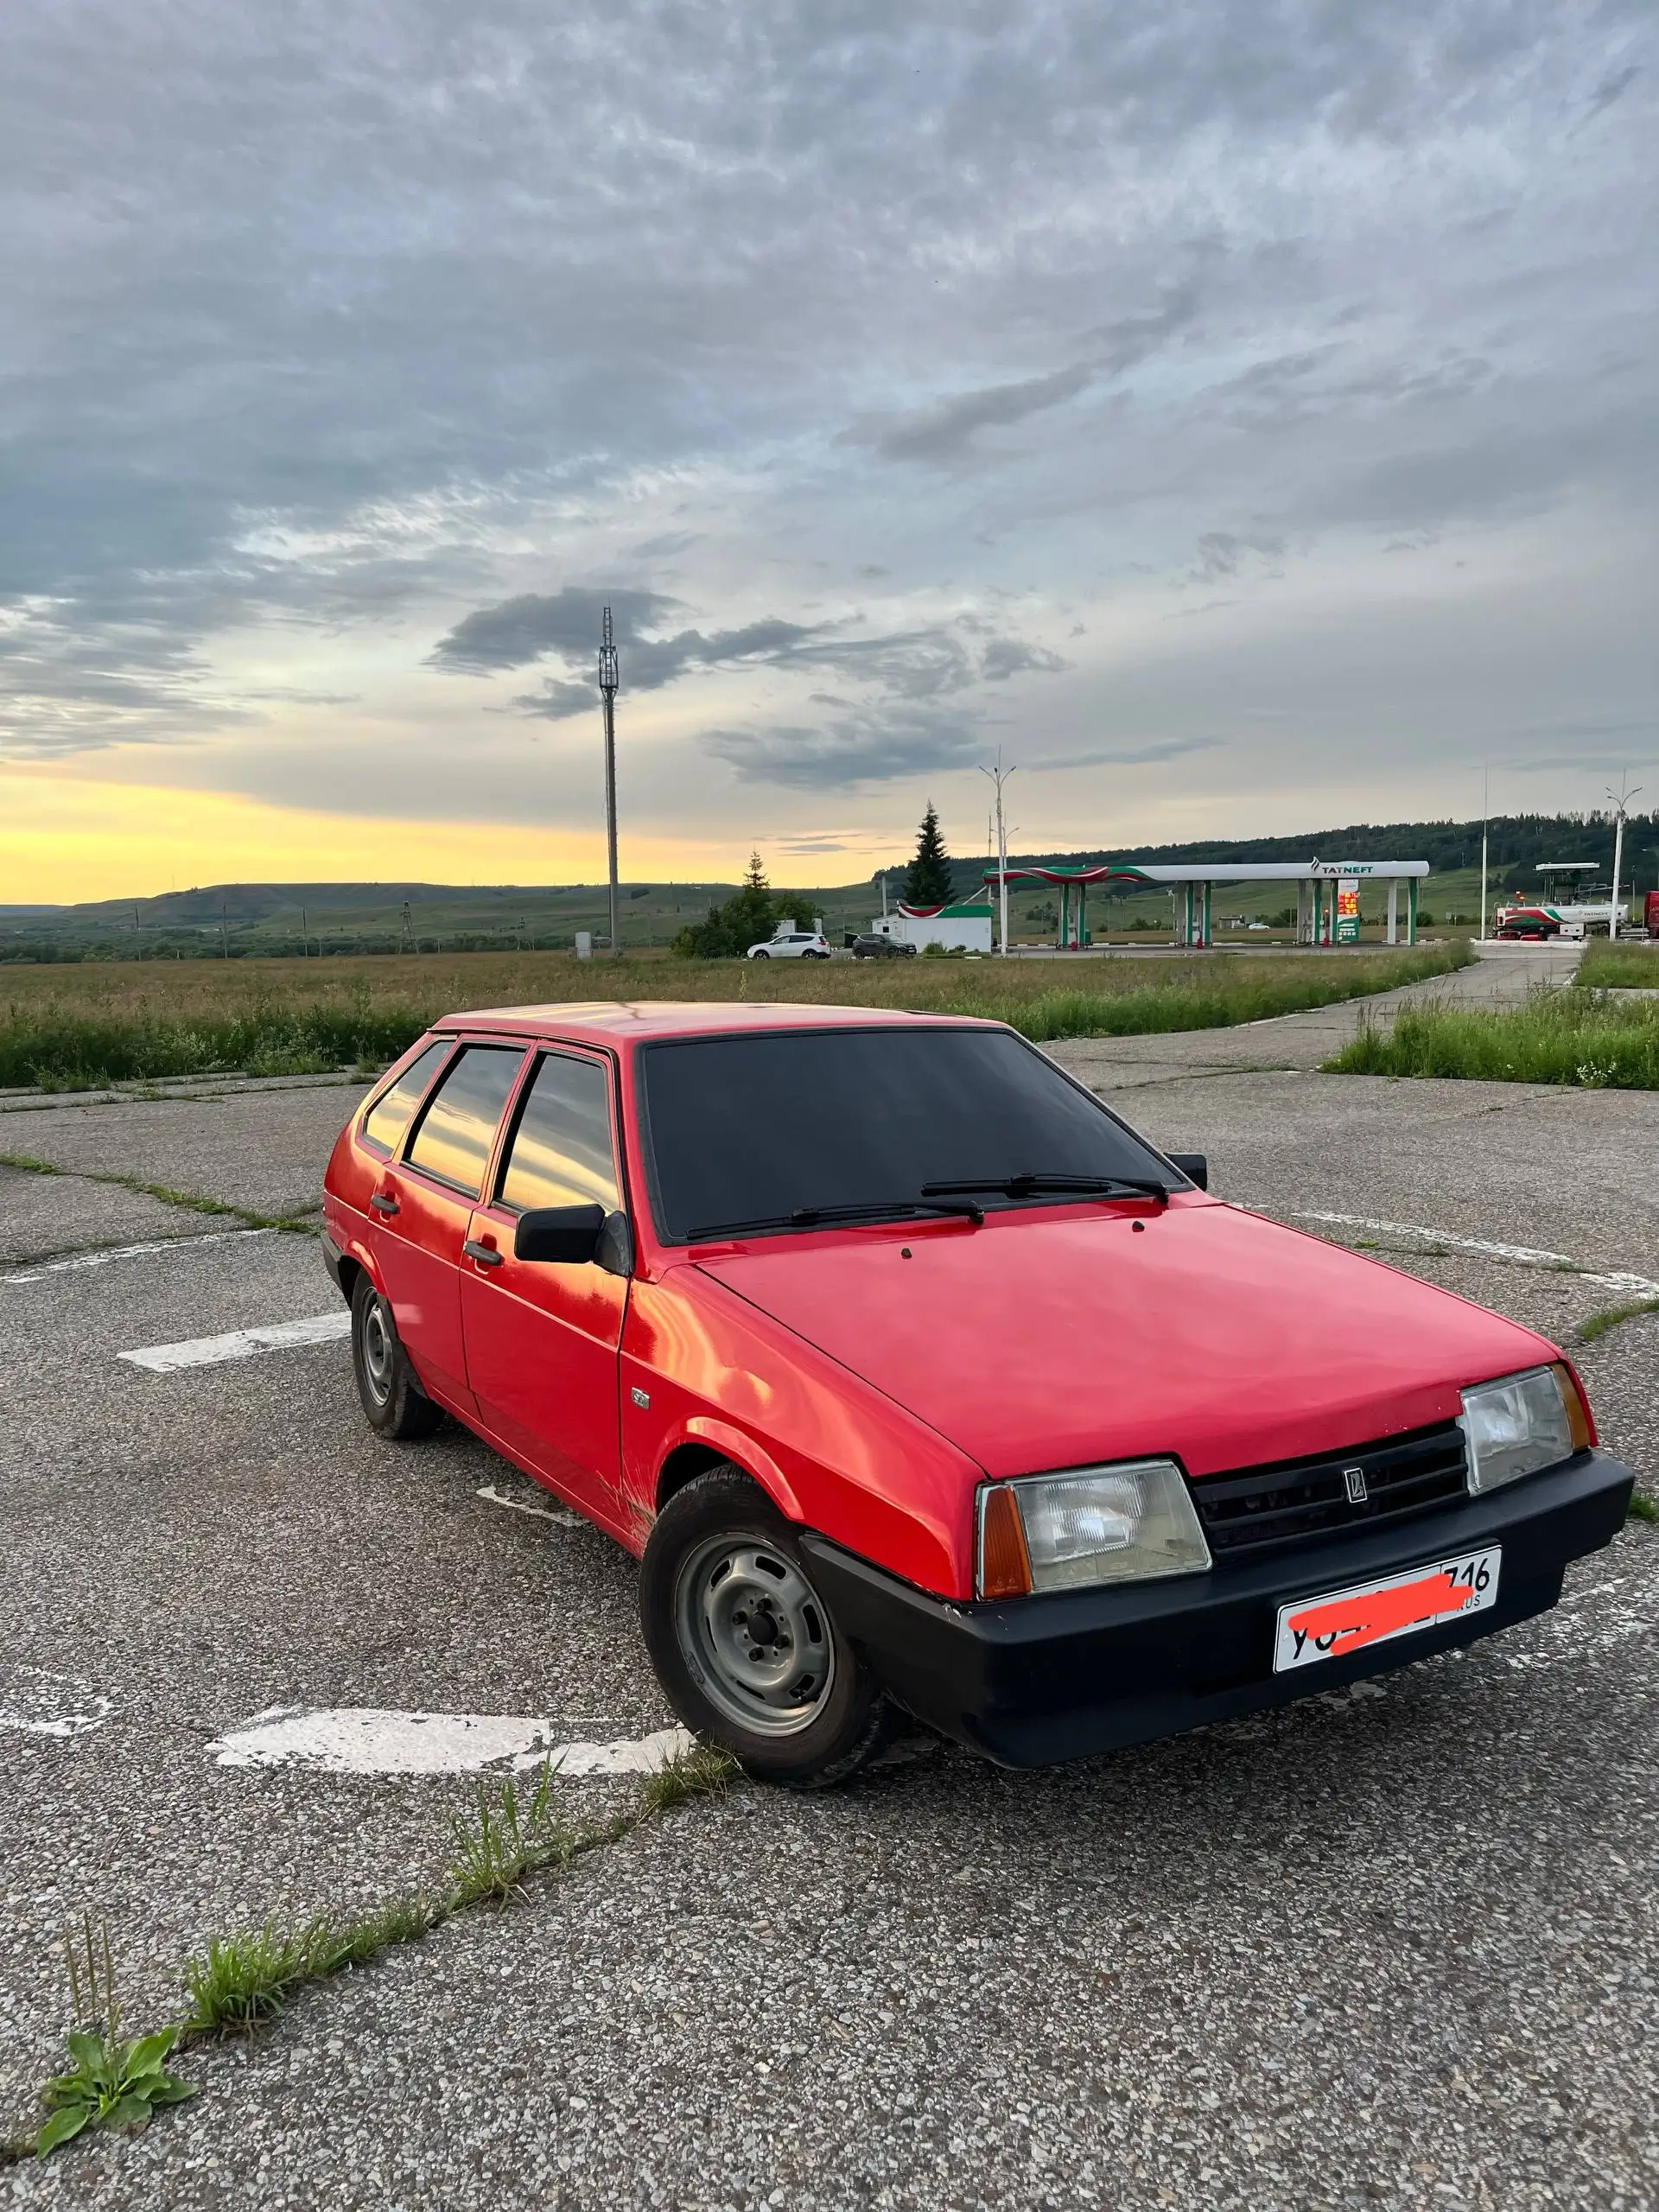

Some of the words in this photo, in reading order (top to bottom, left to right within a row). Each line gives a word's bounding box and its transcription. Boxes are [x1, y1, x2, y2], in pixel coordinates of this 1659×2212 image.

[1322, 866, 1374, 874] TATNEFT
[1444, 1557, 1490, 1592] 716
[1456, 1594, 1481, 1611] US
